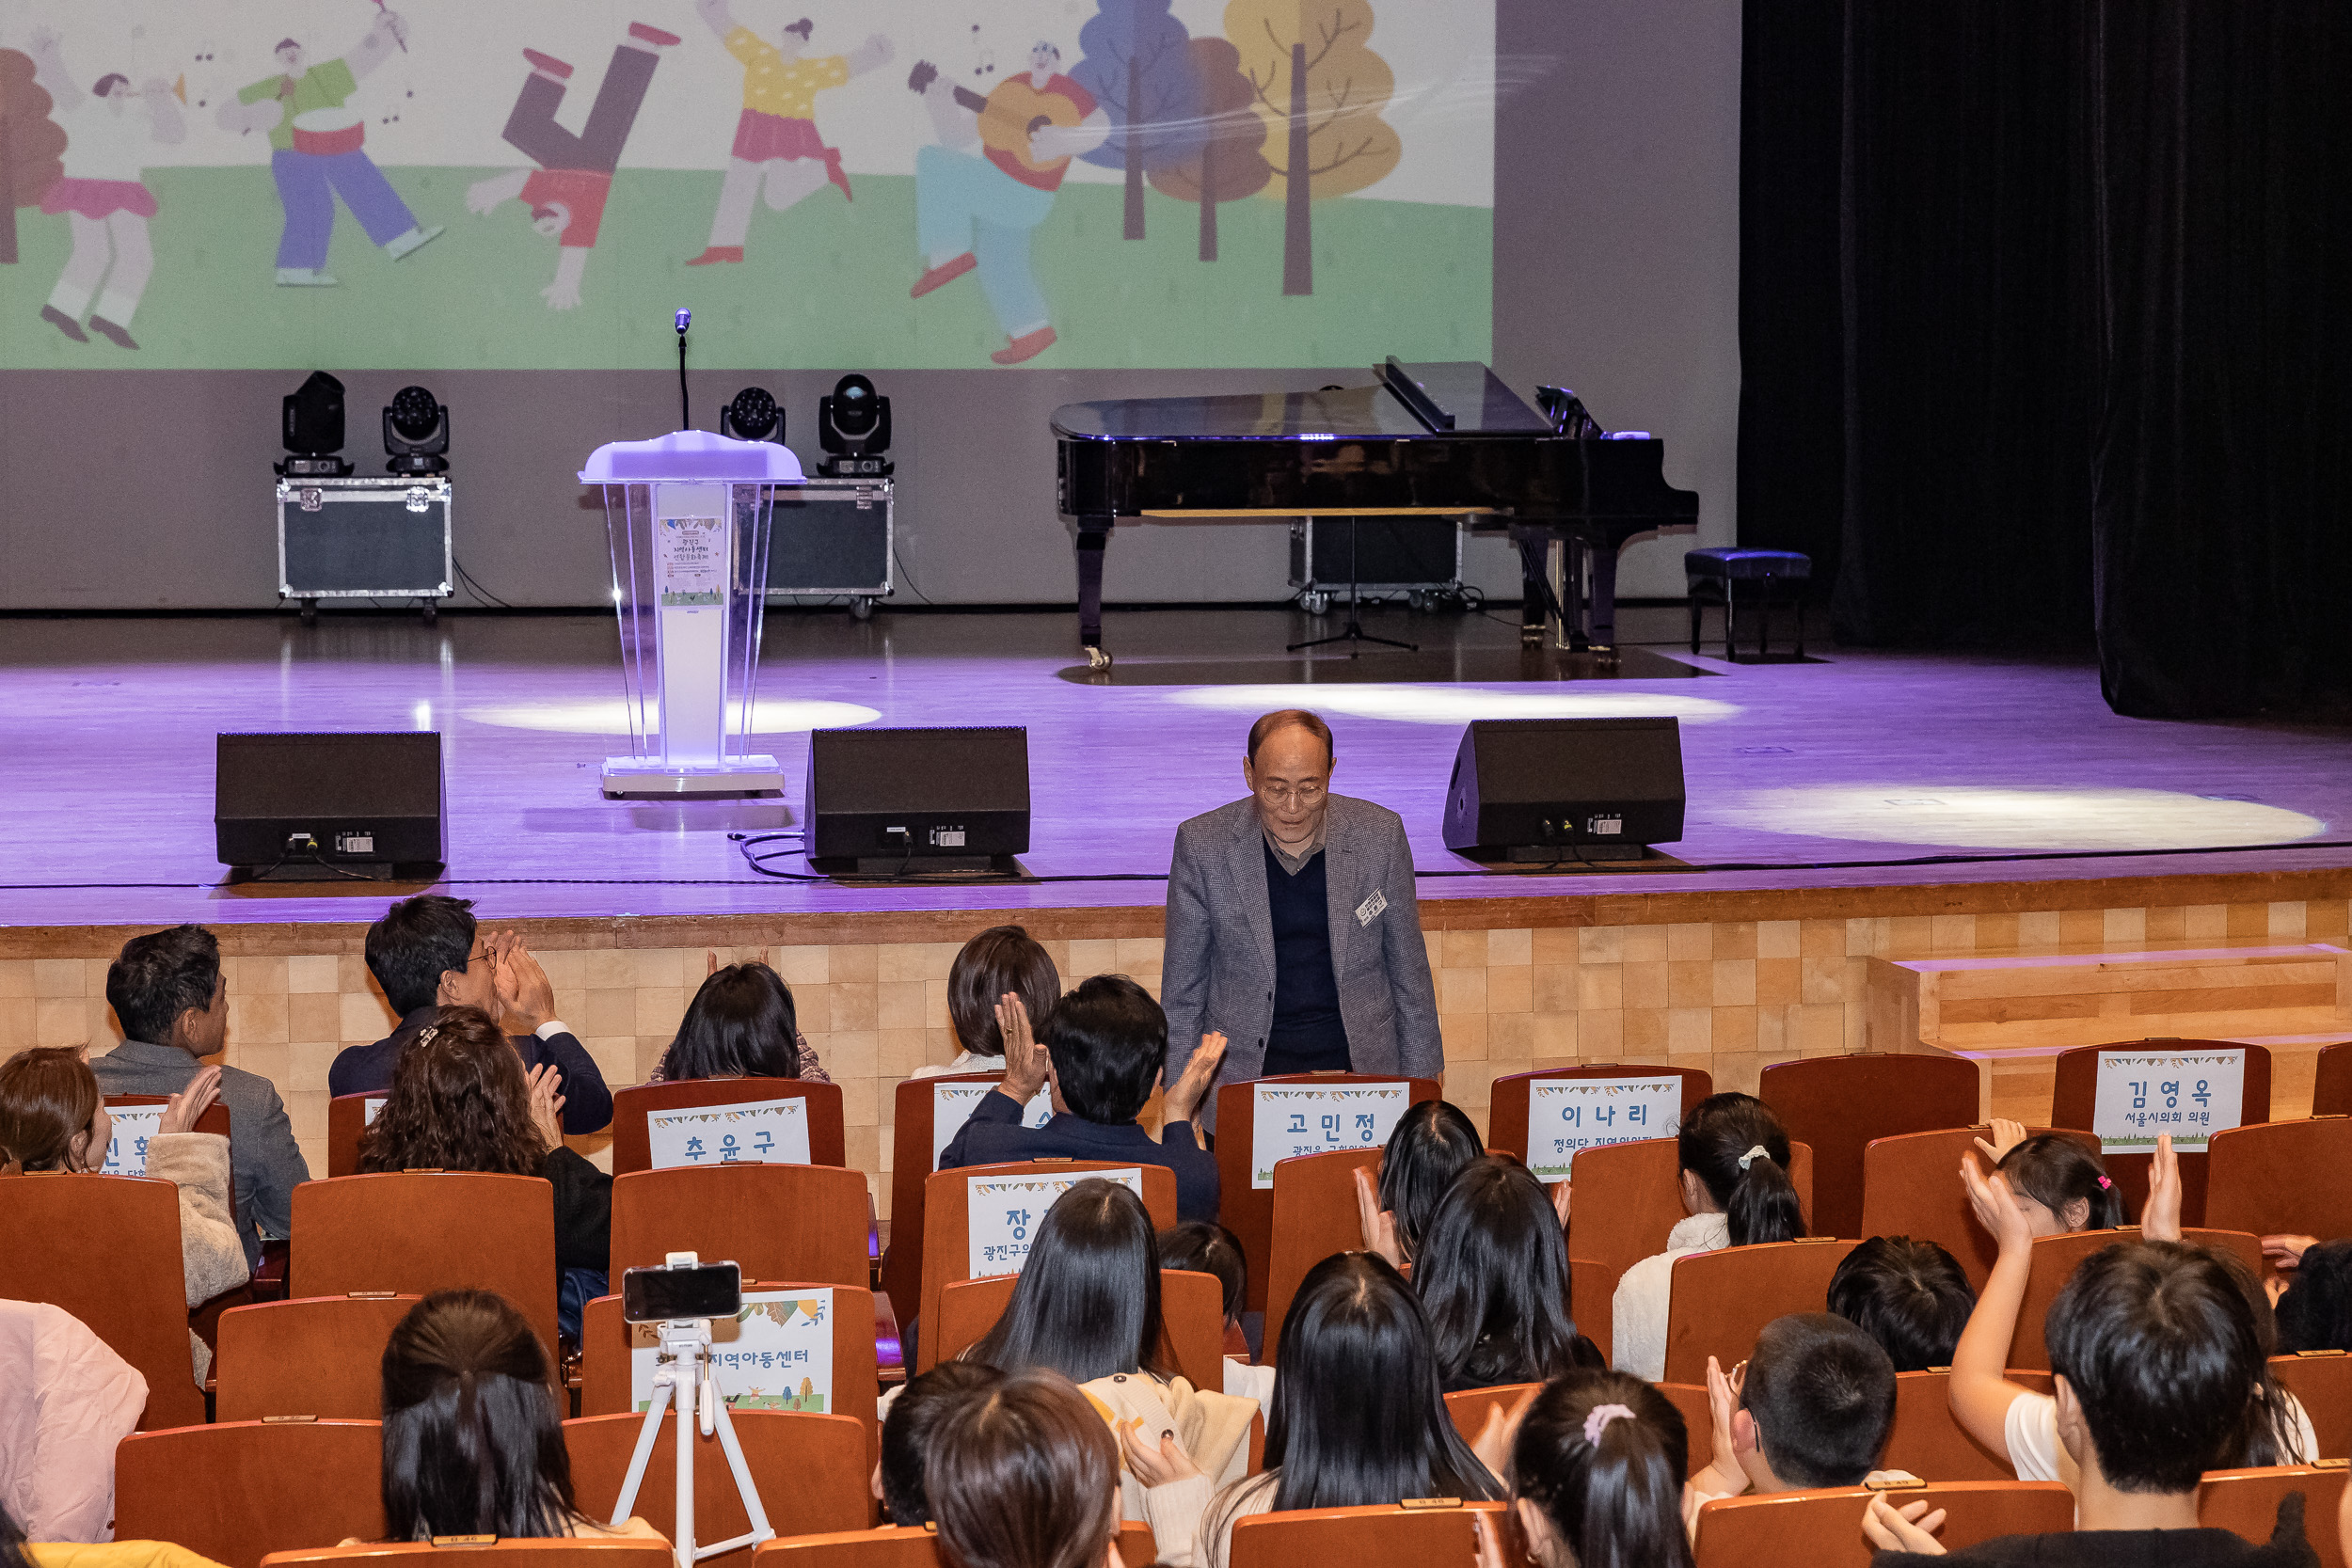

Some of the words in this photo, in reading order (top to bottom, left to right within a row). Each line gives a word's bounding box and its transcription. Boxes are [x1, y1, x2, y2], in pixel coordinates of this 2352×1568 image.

[2128, 1079, 2212, 1109] 김영옥
[1286, 1113, 1375, 1143] 고민정
[1562, 1103, 1647, 1128] 이나리
[2124, 1111, 2183, 1128] 서울시의회
[2187, 1111, 2211, 1126] 의원
[684, 1131, 775, 1161] 추윤구
[710, 1349, 809, 1370] 지역아동센터
